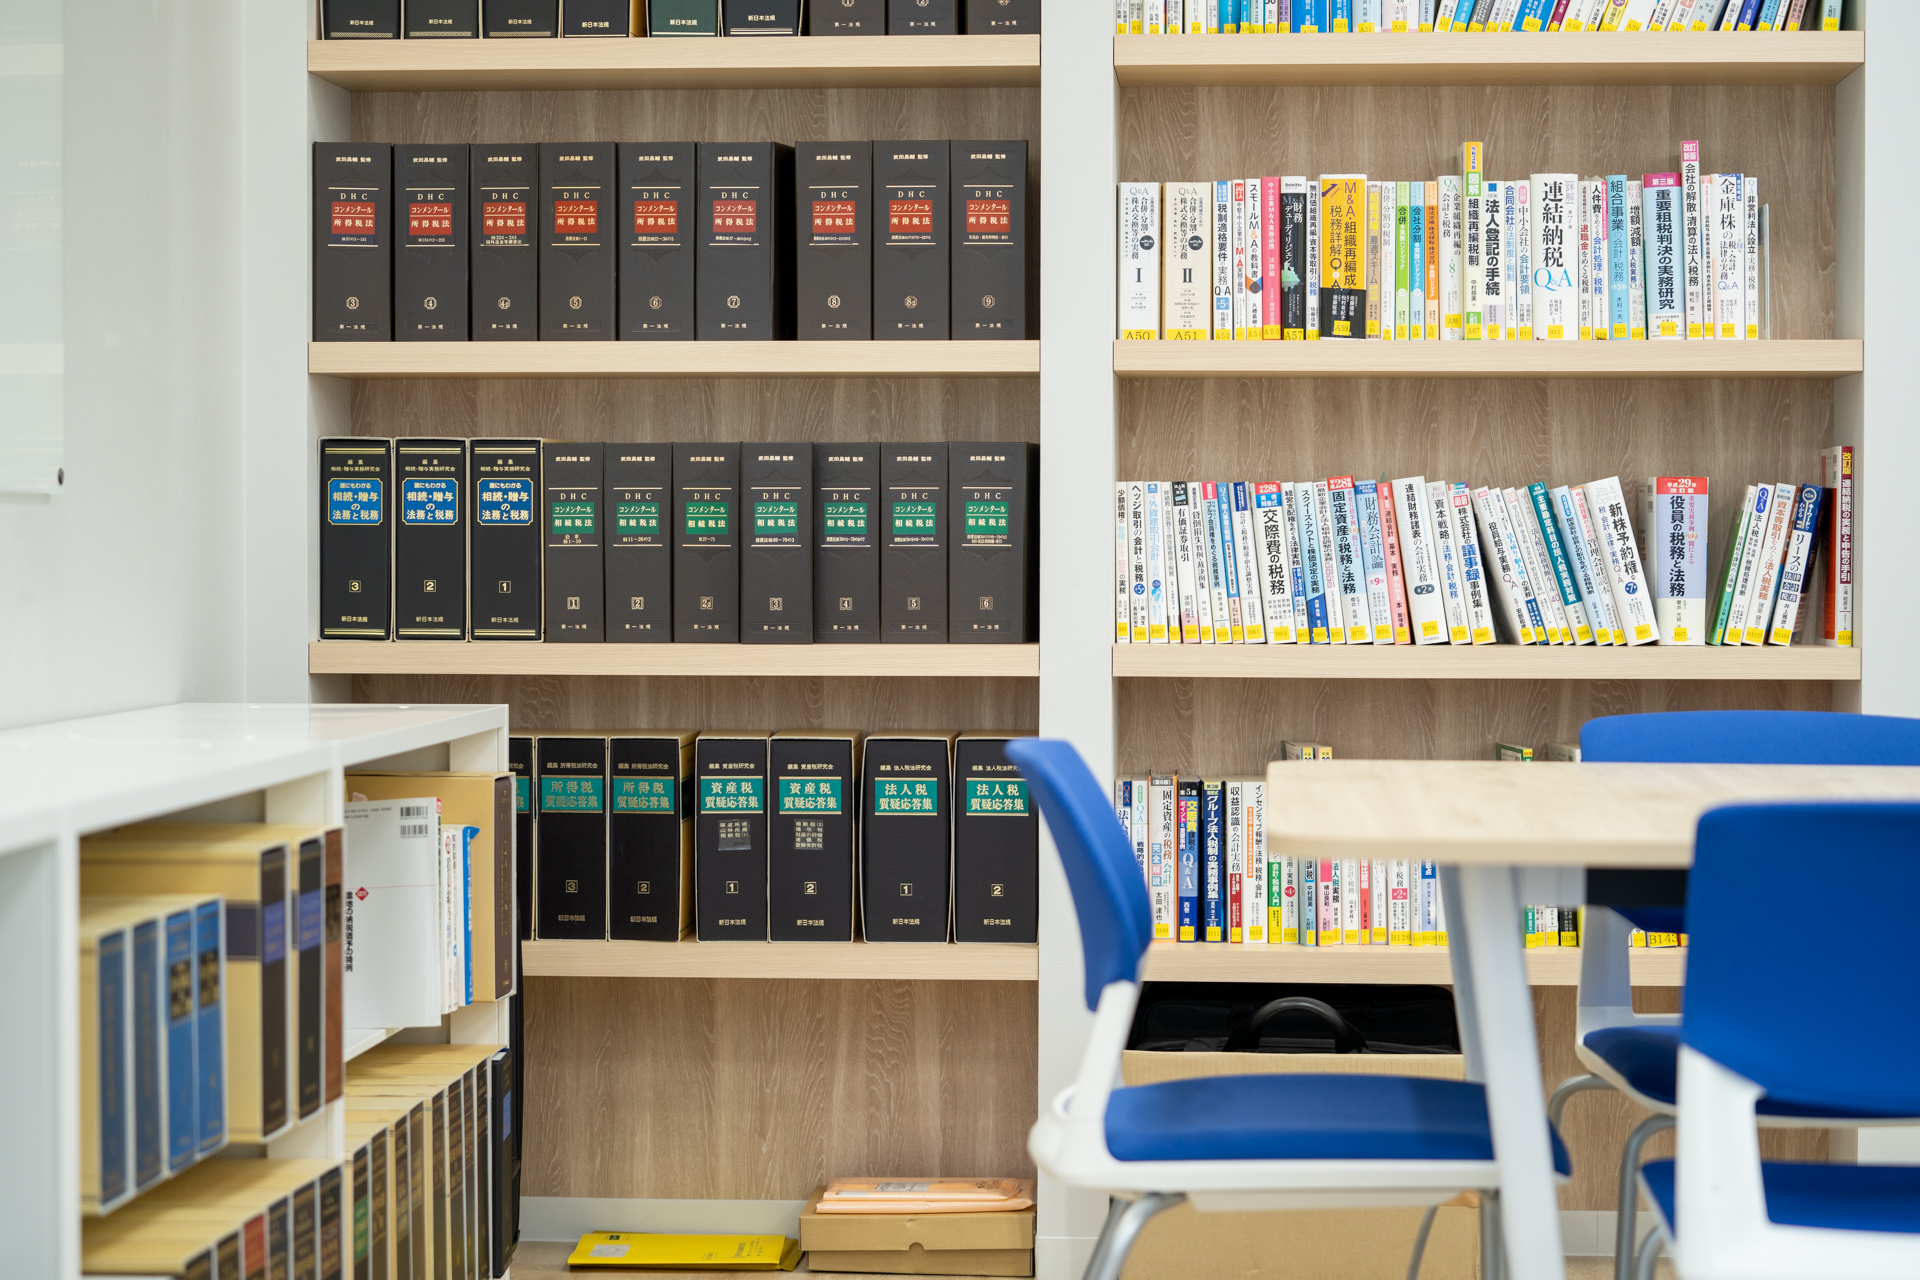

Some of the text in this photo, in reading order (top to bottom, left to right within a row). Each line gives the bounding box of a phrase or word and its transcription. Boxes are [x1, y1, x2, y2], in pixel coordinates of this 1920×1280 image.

[1468, 174, 1479, 195] 図解
[1130, 187, 1149, 195] Q&A
[1179, 187, 1198, 195] Q&A
[333, 206, 372, 214] コンメンタール
[410, 206, 451, 214] コンメンタール
[714, 205, 753, 213] コンメンタール
[968, 203, 1007, 211] コンメンタール
[1293, 203, 1303, 223] 財務
[1720, 179, 1735, 239] 金庫株の
[891, 217, 930, 225] 所得税法
[1442, 193, 1450, 237] 会計と税務
[334, 219, 373, 227] 所得税法
[1131, 197, 1139, 260] 株式交換等の実務
[1180, 197, 1188, 260] 株式交換等の実務
[1453, 193, 1461, 256] 企業組織再編の
[1542, 181, 1564, 267] 連結納税
[1685, 164, 1699, 286] 会社の解散・清算の法人税務
[1249, 184, 1259, 278] スモールM&Aの教科書
[1468, 198, 1479, 266] 組織再編税制
[1611, 181, 1624, 281] 組合事業の会計・税務
[1218, 204, 1227, 285] 税制適格要件の実務
[1593, 184, 1602, 295] 人件費をめぐる会計処理と税務
[1486, 200, 1499, 295] 法人登記の手続
[1519, 206, 1529, 294] 中小会社の会計要領
[1656, 190, 1674, 309] 重要租税判決の実務研究
[1580, 224, 1589, 293] 退職金をめぐる税務
[1534, 267, 1573, 291] Q&A
[1334, 324, 1349, 333] A59
[1125, 330, 1151, 340] A50
[1174, 330, 1199, 340] A51
[1284, 330, 1303, 340] A57
[1843, 453, 1852, 474] 改訂版
[333, 492, 378, 502] 相続・贈与
[407, 491, 454, 502] 相続・贈与
[482, 492, 529, 502] 相続・贈与
[553, 506, 593, 514] コンメンタール
[687, 506, 725, 514] コンメンタール
[826, 506, 866, 514] コンメンタール
[967, 505, 1007, 513] コンメンタール
[332, 510, 379, 521] 法務と税務
[406, 510, 454, 521] 法務と税務
[482, 510, 529, 521] 法務と税務
[895, 519, 933, 527] 相続税法
[968, 518, 1006, 526] 相続税法
[1132, 485, 1144, 582] ヘッジ取引の会計と税務
[1285, 491, 1300, 566] 経営支配権をめぐる法律実務
[1365, 497, 1383, 569] 財務会計論
[1405, 484, 1427, 582] 連結財務諸表の会計実務
[1841, 479, 1851, 582] 連結納税の実務と申告の手引
[1178, 508, 1190, 562] 有価証券取引
[1609, 502, 1638, 580] 新株予約権の
[1302, 490, 1320, 593] スクイーズ・アウトと株価決定の実務
[1332, 491, 1356, 594] 固定資産の税務と法務
[1669, 495, 1685, 597] 役員の税務と法務
[1263, 510, 1285, 595] 交際費の税務
[1458, 508, 1483, 608] 株式会社の議事録事例集
[352, 582, 358, 590] 3
[427, 582, 433, 590] 2
[551, 781, 593, 793] 所得税
[623, 782, 664, 794] 所得税
[711, 782, 753, 794] 資産税
[790, 782, 831, 794] 資産税
[885, 784, 927, 795] 法人税
[977, 784, 1019, 796] 法人税
[546, 795, 598, 808] 質疑応答集
[618, 796, 669, 808] 質疑応答集
[706, 796, 758, 808] 質疑応答集
[784, 797, 836, 809] 質疑応答集
[879, 798, 932, 810] 質疑応答集
[971, 798, 1024, 810] 質疑応答集
[1187, 800, 1197, 851] 交際費課税の
[1230, 787, 1240, 871] 収益認識の会計実務
[1207, 796, 1219, 899] グループ法人税制の実務事例集
[1152, 844, 1161, 885] 完全解説
[1183, 853, 1194, 889] Q&A
[1390, 933, 1412, 942] B126
[1561, 934, 1576, 943] B138
[1648, 933, 1678, 945] B143
